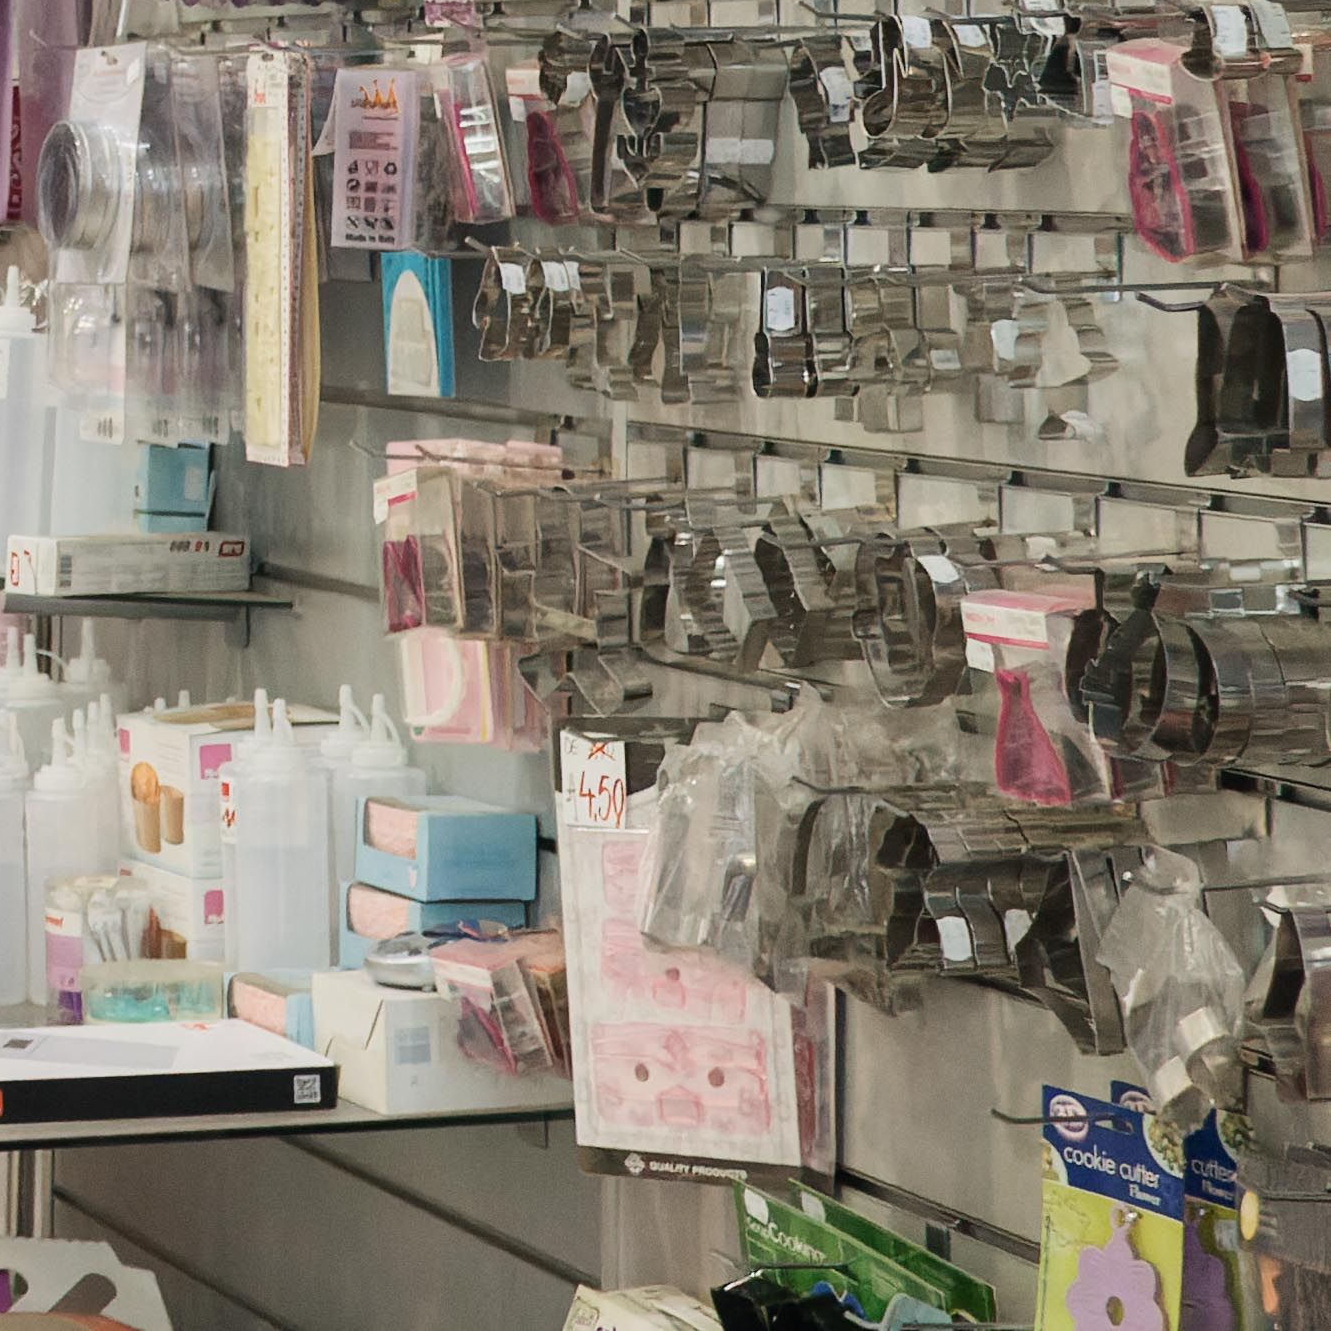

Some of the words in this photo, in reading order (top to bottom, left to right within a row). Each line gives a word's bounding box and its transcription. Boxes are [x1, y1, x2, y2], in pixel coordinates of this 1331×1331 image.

[649, 1160, 690, 1174] QUALITY
[692, 1165, 748, 1180] PRODUCTS
[1064, 1144, 1117, 1176] cookie
[1118, 1161, 1161, 1189] cutter
[1129, 1182, 1162, 1207] Flower
